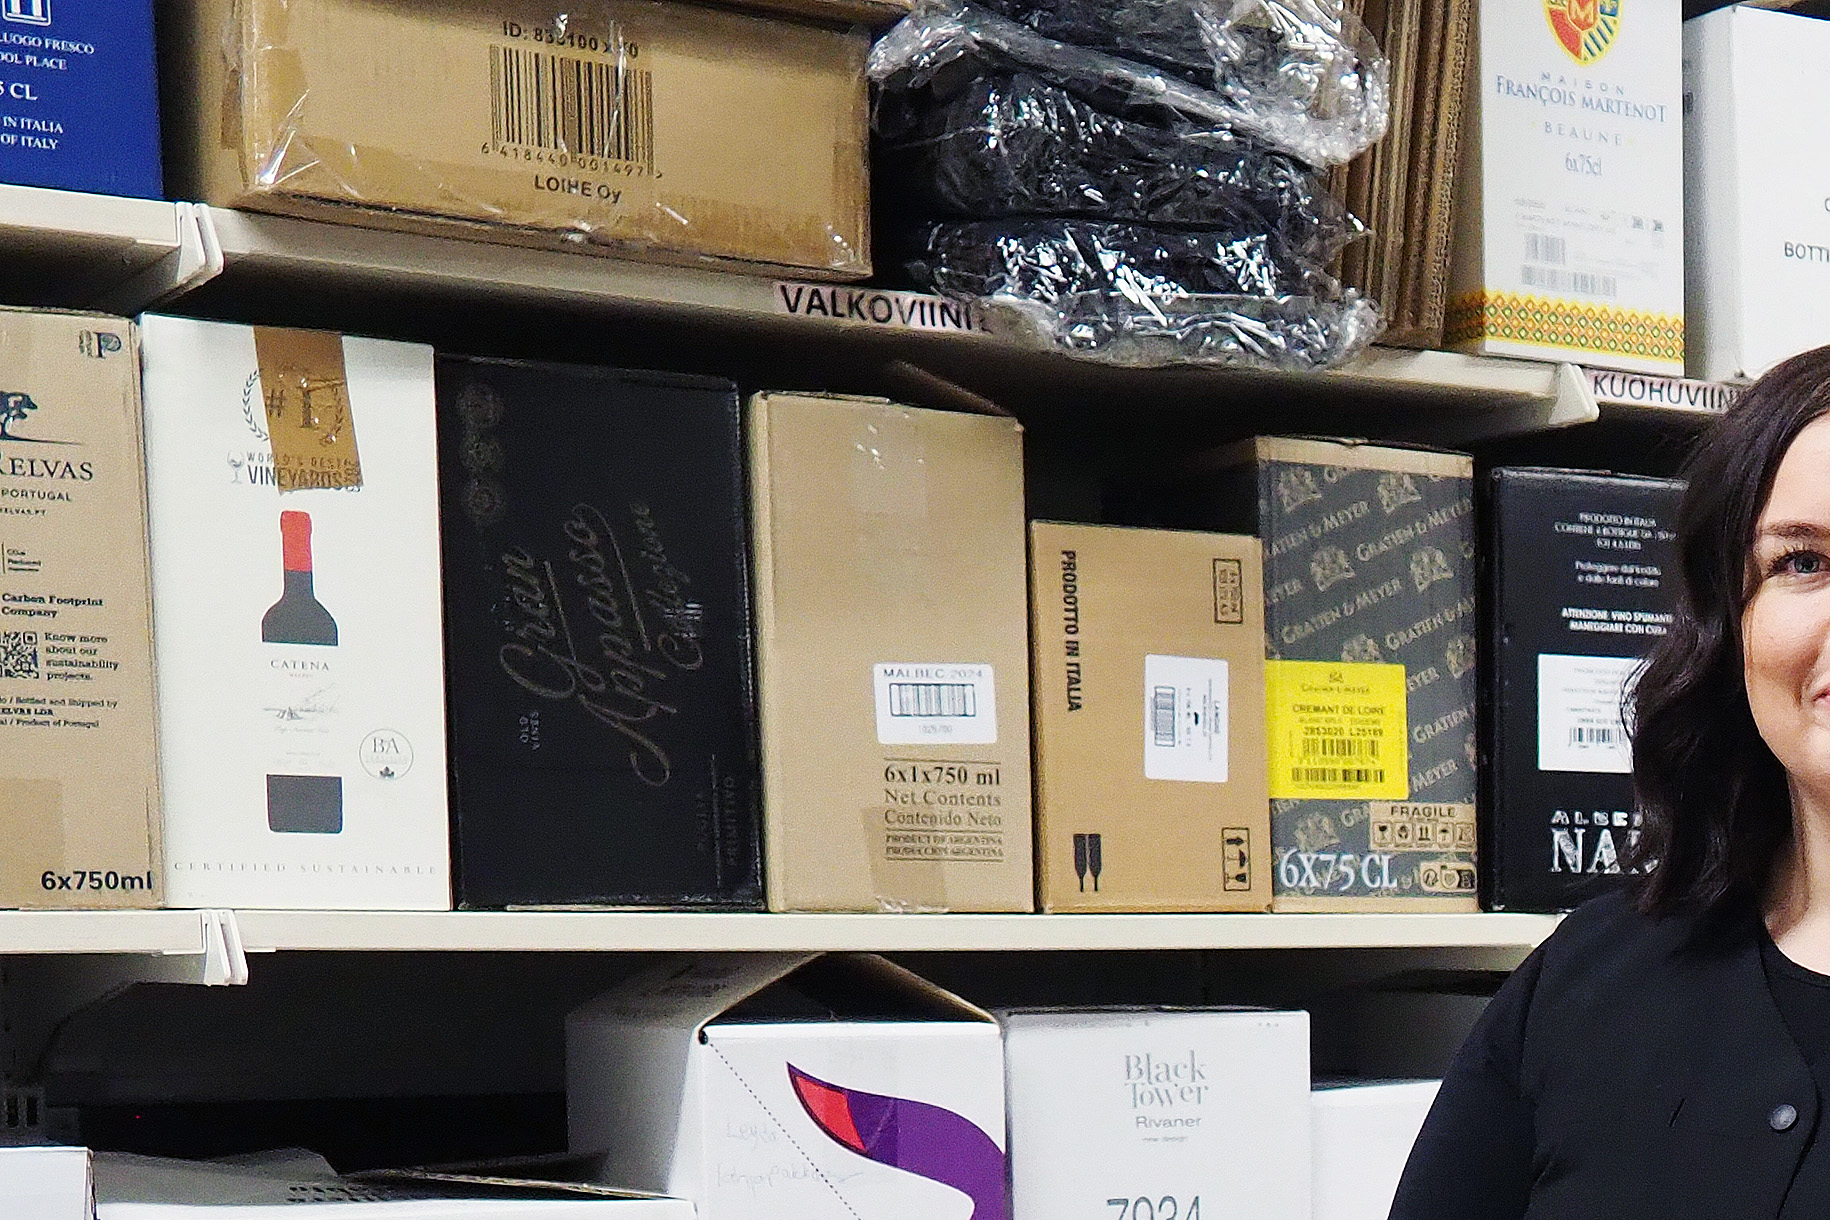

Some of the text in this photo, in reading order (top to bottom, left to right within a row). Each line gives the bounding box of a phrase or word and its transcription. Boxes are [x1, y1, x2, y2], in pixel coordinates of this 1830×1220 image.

[45, 37, 95, 55] FRESCO
[25, 54, 67, 70] PLACE
[10, 83, 38, 101] CL
[1541, 72, 1624, 95] MAISON
[1497, 75, 1667, 122] FRANÇOIS MARTENOT
[3, 116, 64, 135] IN ITALIA
[1544, 121, 1622, 147] BEAUNE
[19, 135, 59, 150] ITALY
[596, 183, 622, 204] Oy
[1592, 376, 1737, 410] KUOHUVIIN
[1, 488, 72, 503] PORTUGAL
[2, 606, 58, 620] Company
[45, 633, 108, 645] Know more
[1061, 550, 1082, 712] PRODOTTO IN ITALIA
[46, 646, 98, 657] about our
[46, 658, 119, 672] sustainability
[270, 659, 330, 672] CATENA
[884, 667, 945, 679] MALBEC
[885, 764, 1001, 785] 6x1x750 ml
[885, 789, 1001, 807] Net Contents
[885, 811, 1001, 827] Contenido Neto
[1390, 805, 1456, 819] FRAGILE
[174, 861, 437, 876] CERTIFIED SUSTAINABLE
[1280, 850, 1398, 889] 6X75 CL
[40, 870, 153, 893] 6x750ml
[1124, 1049, 1207, 1083] Black
[1124, 1080, 1210, 1110] Tower
[1135, 1113, 1202, 1129] Rivaner
